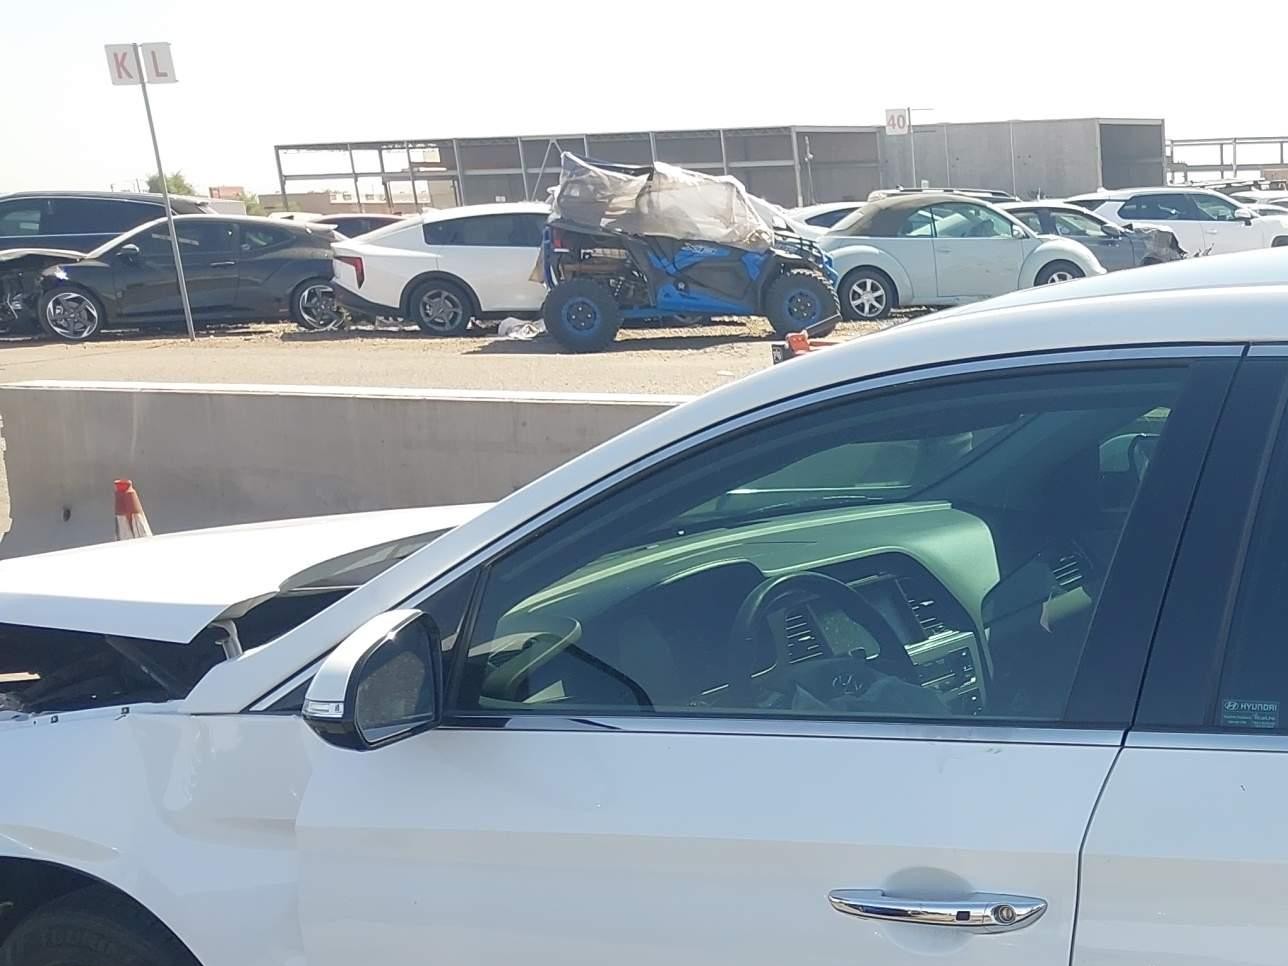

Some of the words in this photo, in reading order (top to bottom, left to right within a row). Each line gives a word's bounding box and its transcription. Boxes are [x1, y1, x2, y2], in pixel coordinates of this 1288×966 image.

[113, 51, 134, 80] K
[150, 50, 169, 78] L
[887, 113, 907, 130] 40
[1240, 702, 1278, 712] HYUNDAI
